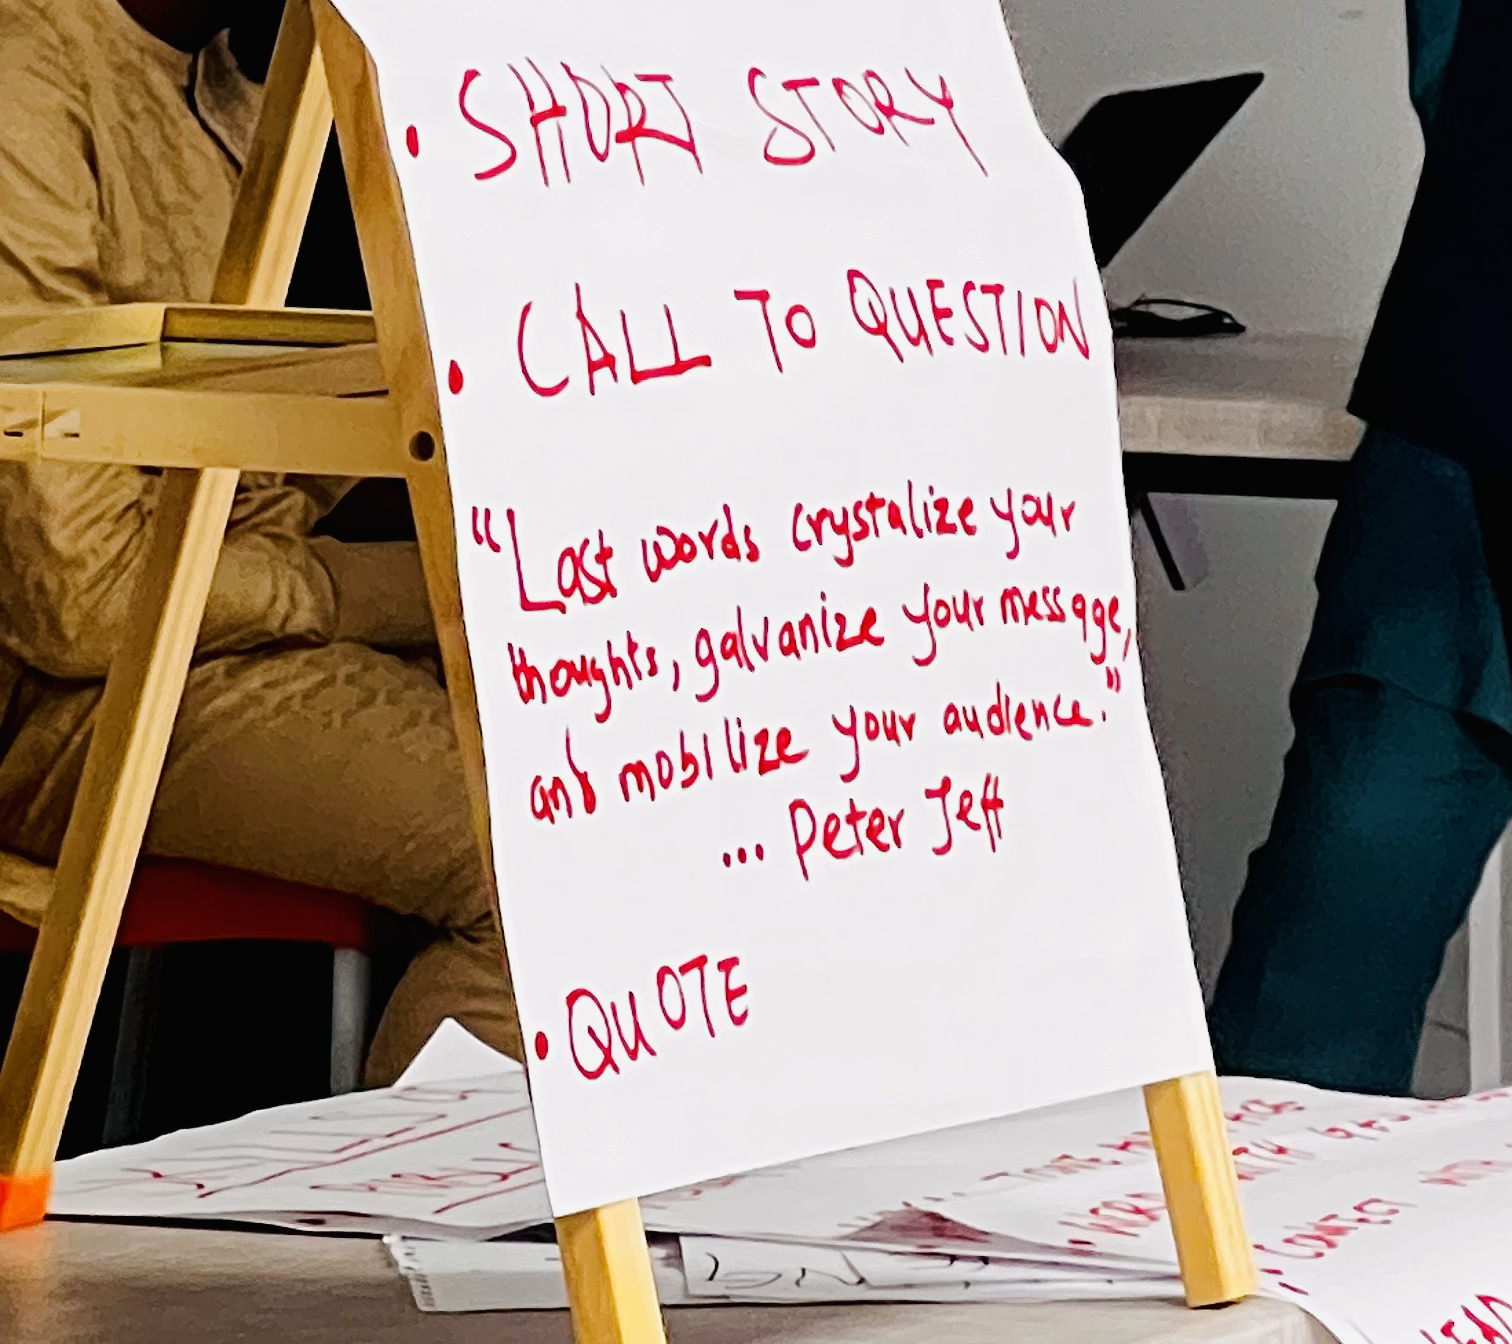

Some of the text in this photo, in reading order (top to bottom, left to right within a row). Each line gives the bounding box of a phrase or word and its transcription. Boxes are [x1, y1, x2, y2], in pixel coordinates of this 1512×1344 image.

[457, 57, 988, 188] SHORT STORY
[516, 268, 1092, 398] CALL TO QUESTION
[642, 503, 761, 585] words
[989, 487, 1077, 561] your
[507, 630, 681, 725] thoughts,
[693, 590, 886, 704] galvanize
[901, 582, 985, 668] your
[530, 724, 597, 825] and
[618, 716, 810, 807] mobilize
[831, 703, 917, 785] your
[788, 797, 906, 882] Peter
[923, 772, 1006, 857] Jeff
[565, 953, 750, 1081] QUOTE
